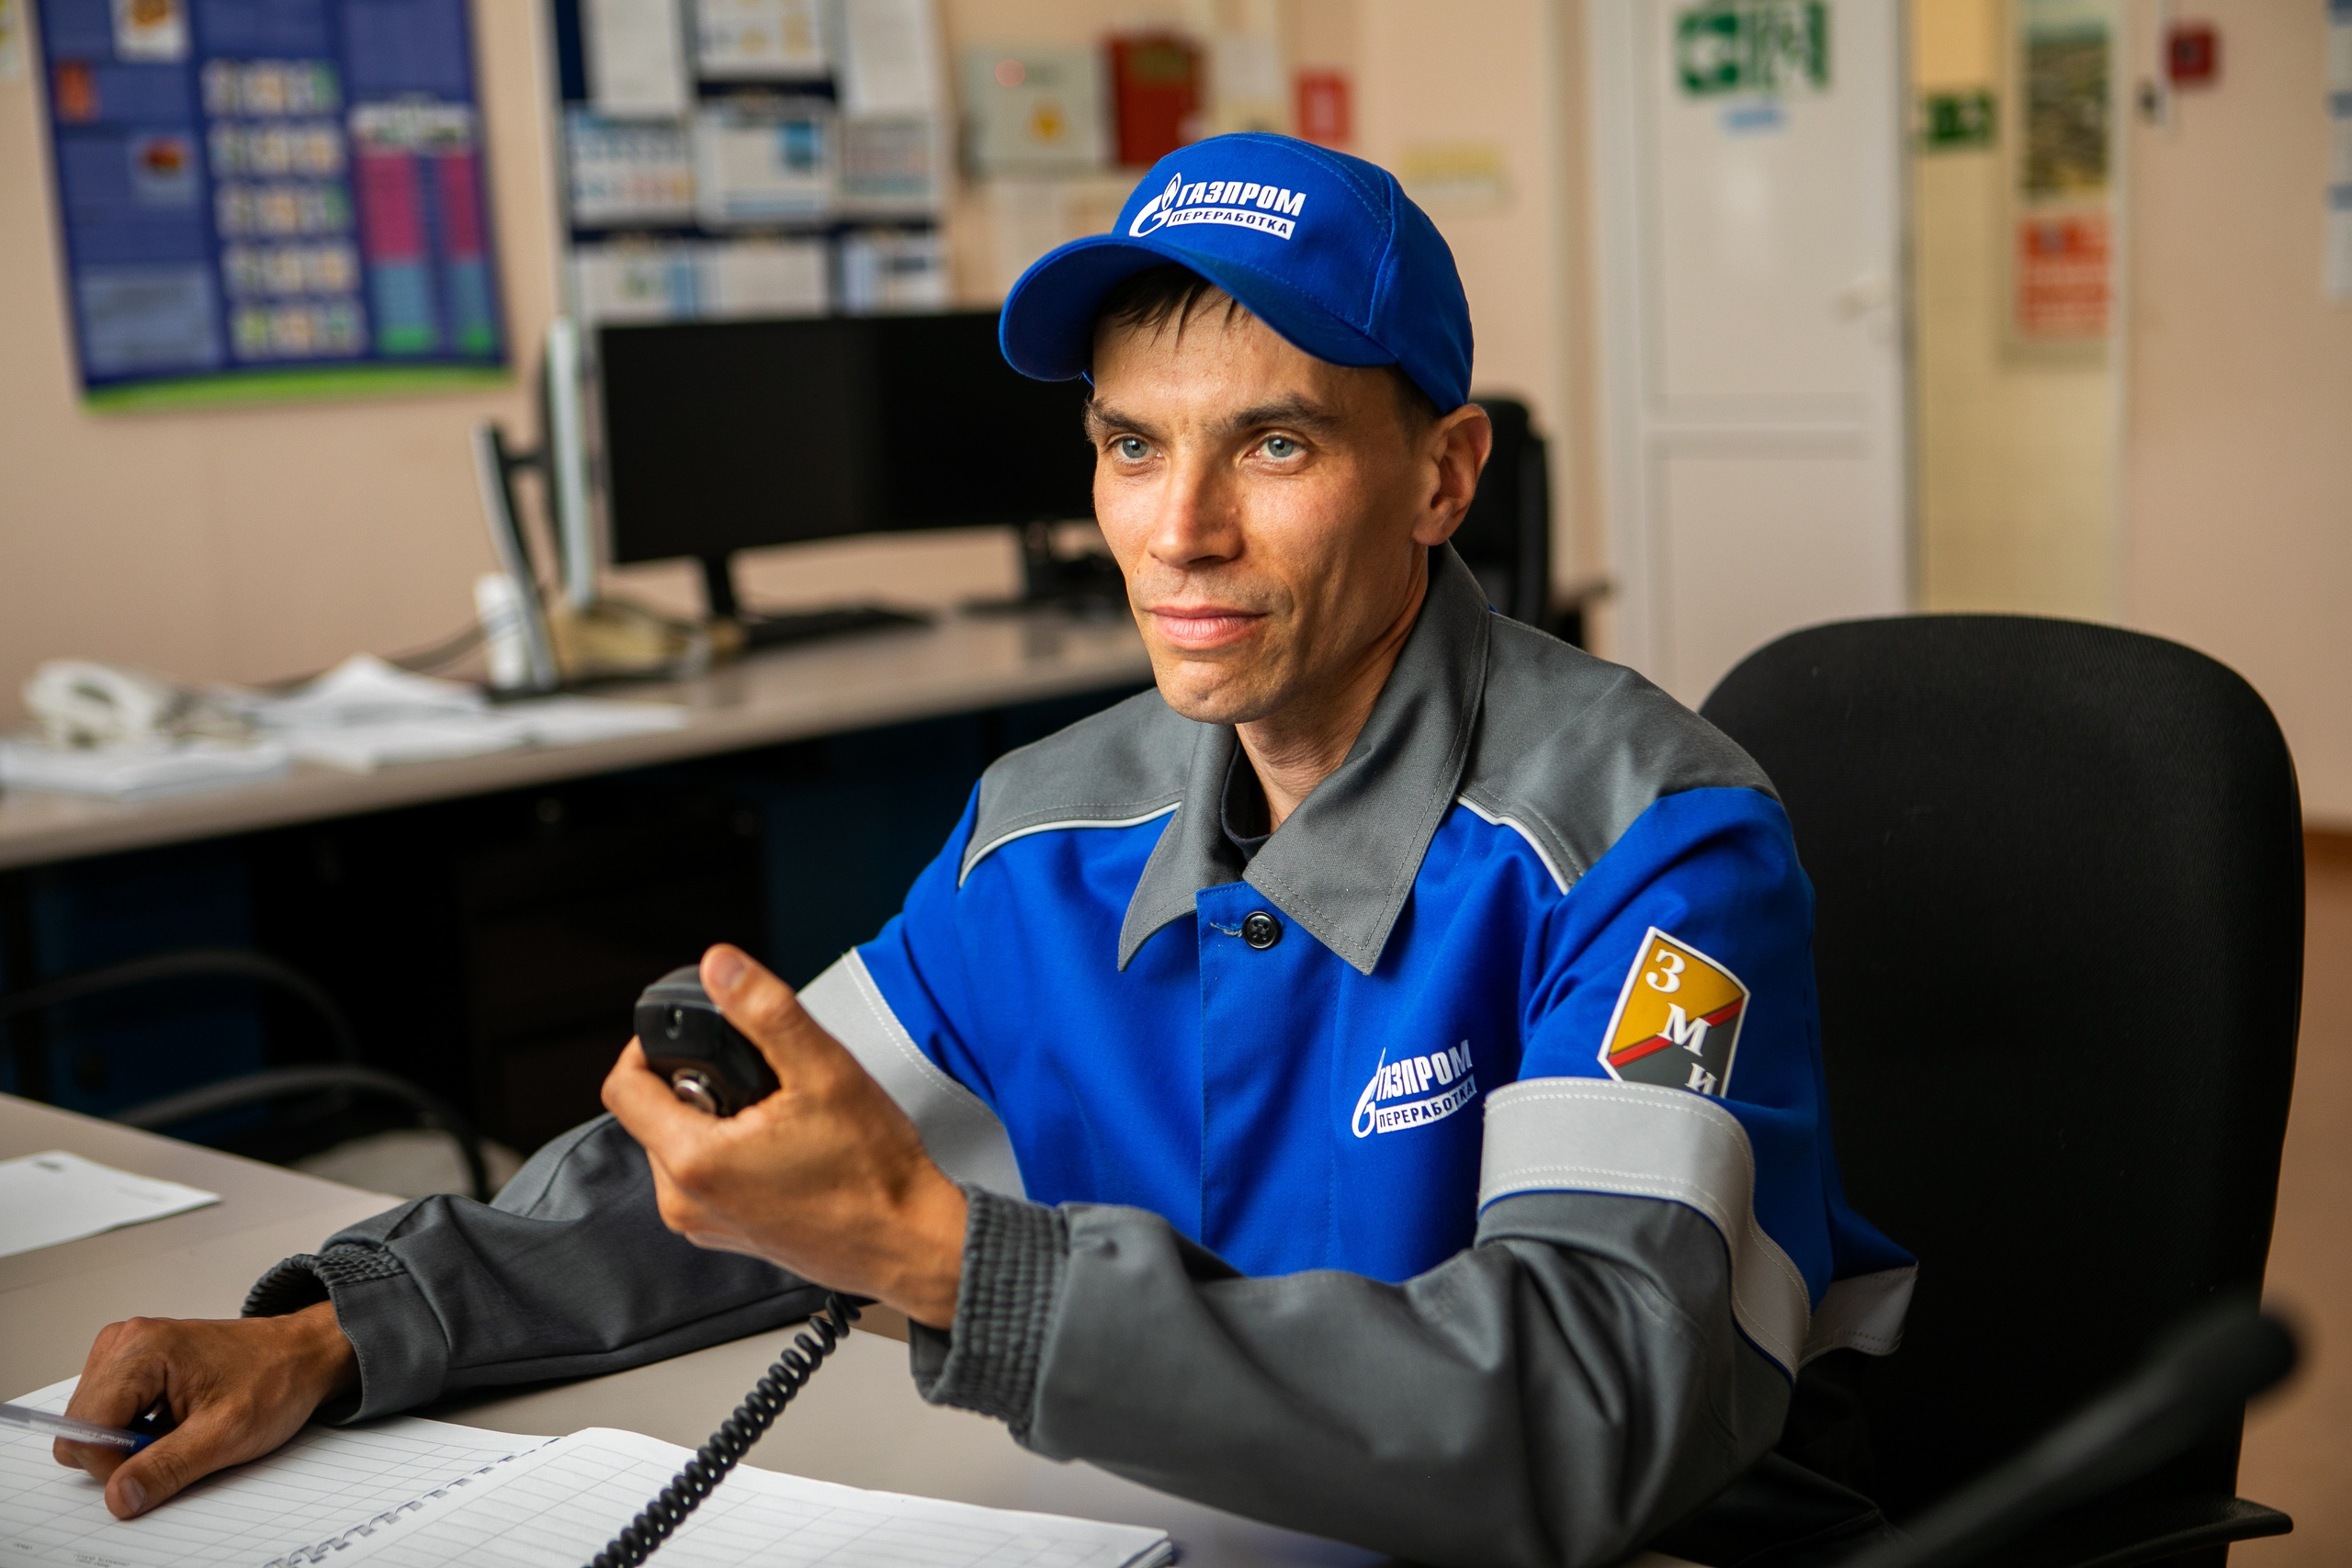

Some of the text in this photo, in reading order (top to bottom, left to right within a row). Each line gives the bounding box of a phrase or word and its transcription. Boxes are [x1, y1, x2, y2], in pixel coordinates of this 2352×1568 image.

[1175, 181, 1306, 217] ГАЗПРОМ
[1171, 209, 1288, 234] ПЕРЕРАБОТКА
[1375, 1039, 1473, 1101] ГАЗПРОМ
